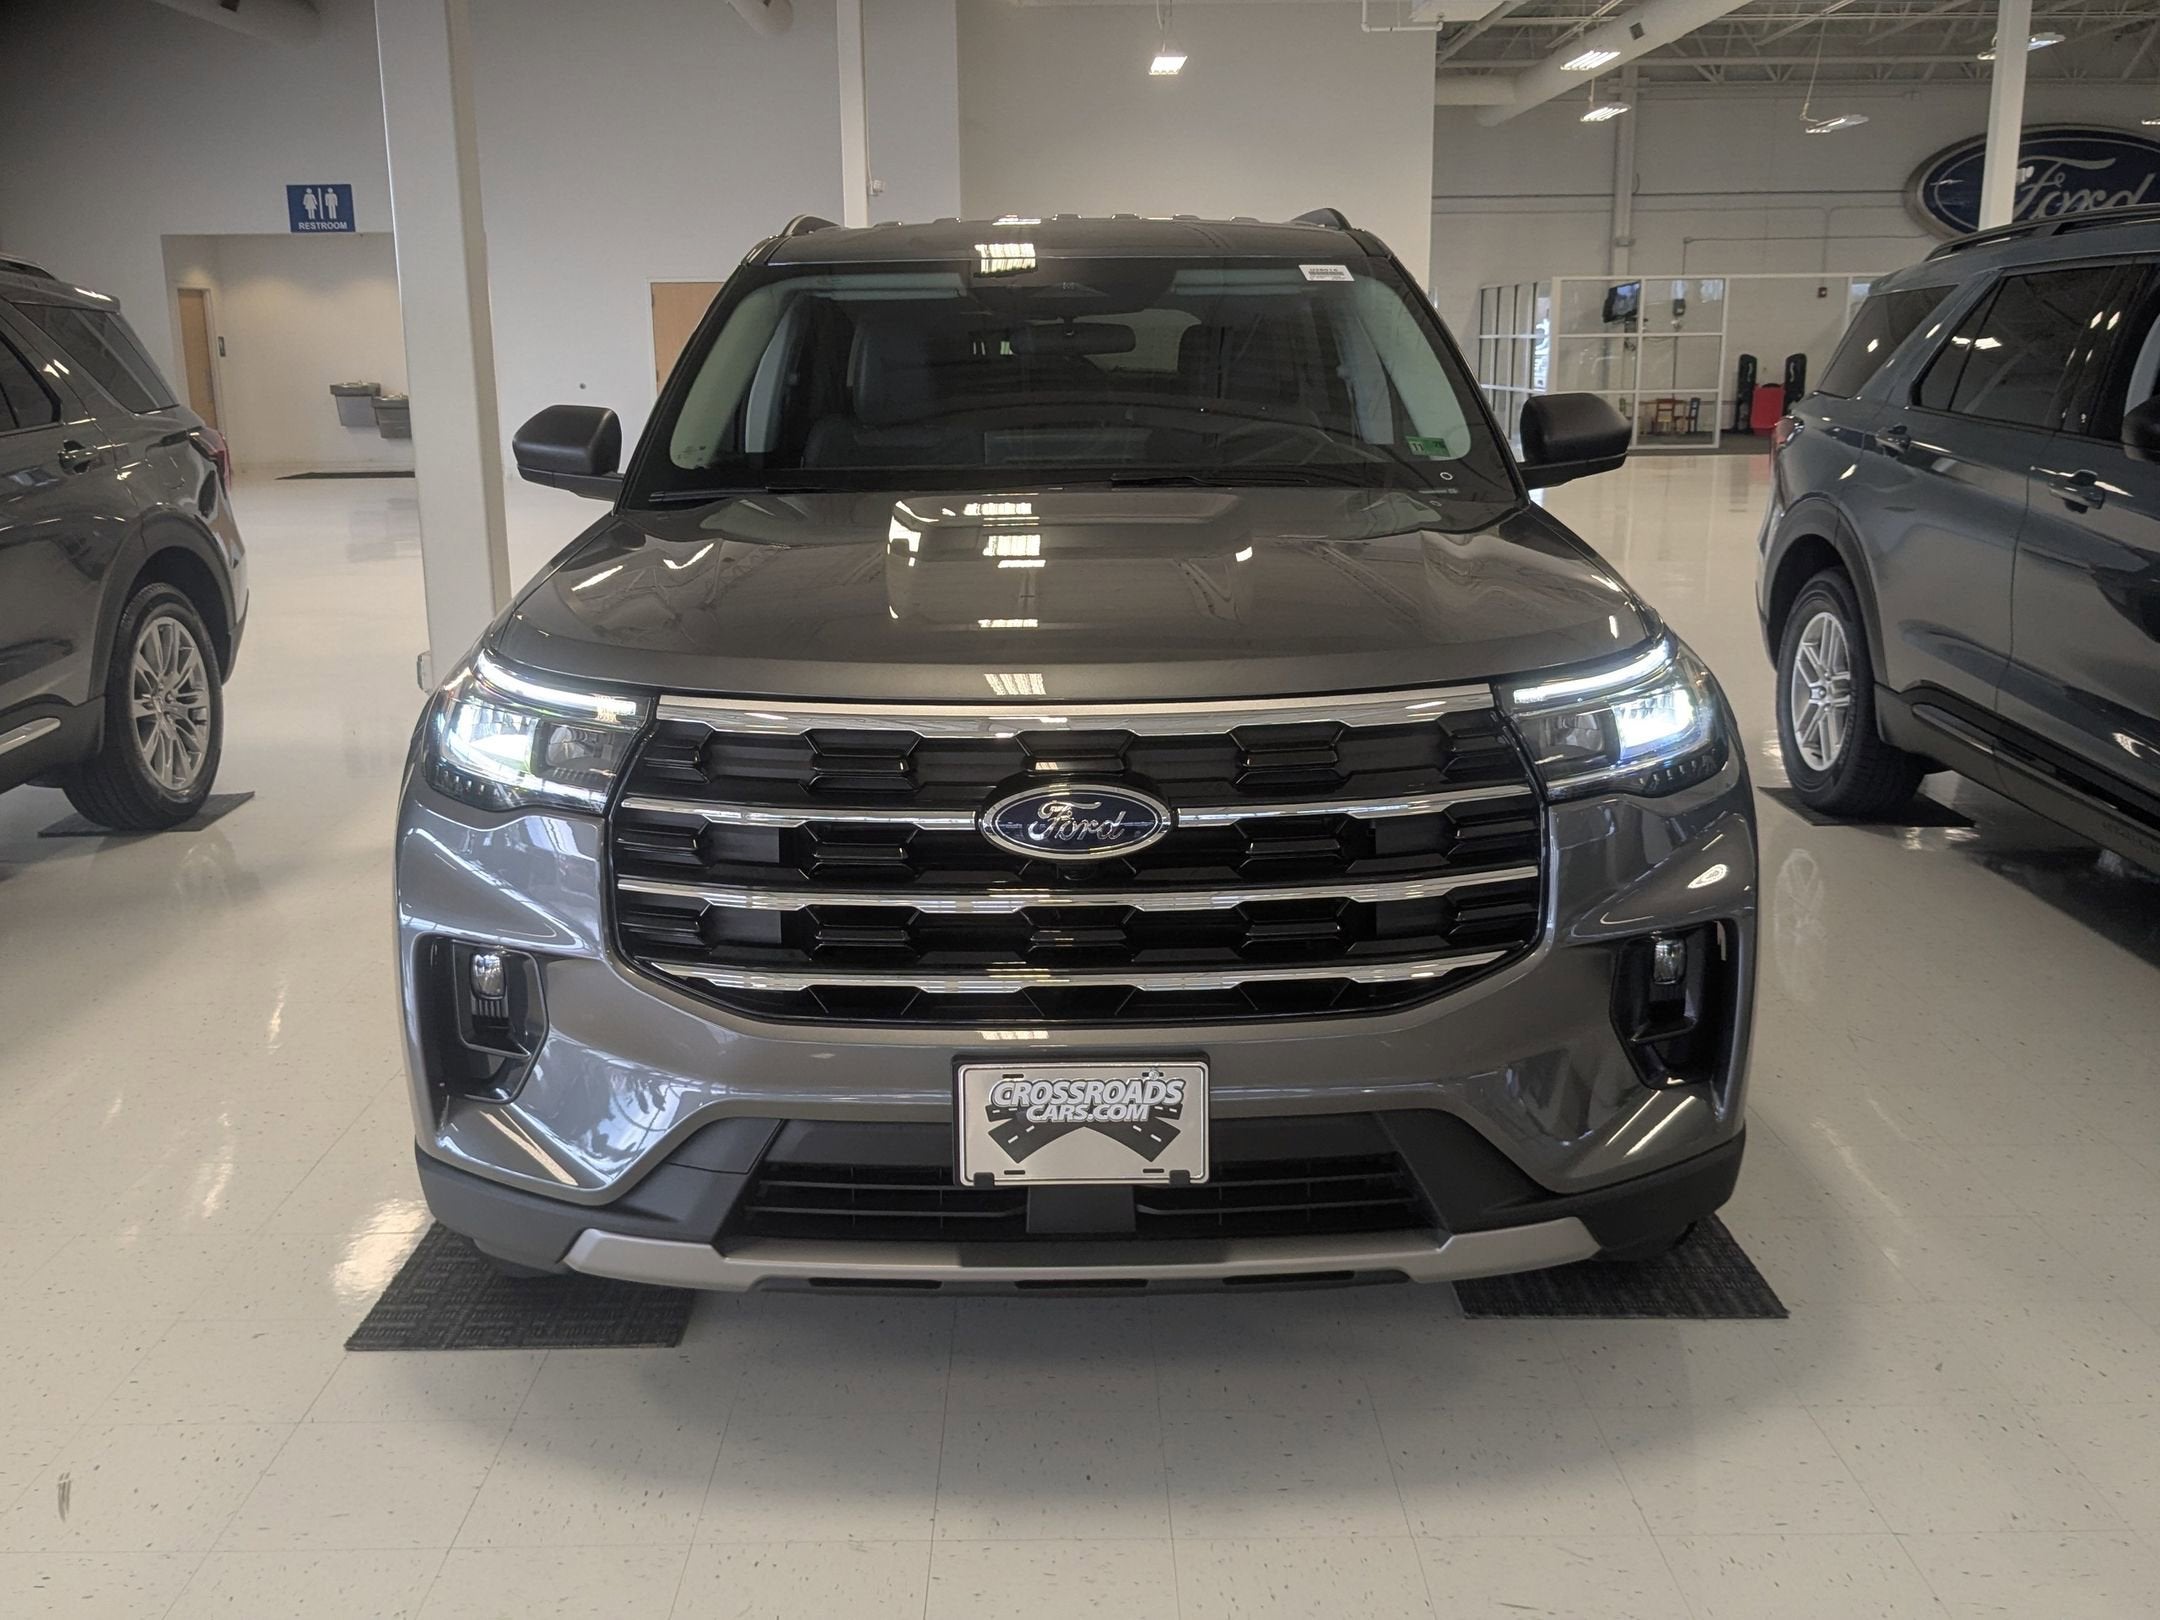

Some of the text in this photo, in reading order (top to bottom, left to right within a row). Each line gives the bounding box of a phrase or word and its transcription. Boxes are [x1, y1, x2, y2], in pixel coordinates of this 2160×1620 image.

[2012, 155, 2156, 220] Ford
[298, 221, 348, 230] RESTROOM
[1027, 799, 1127, 841] Ford
[989, 1079, 1186, 1107] CROSSROADS
[1026, 1103, 1149, 1122] CARS.COM
